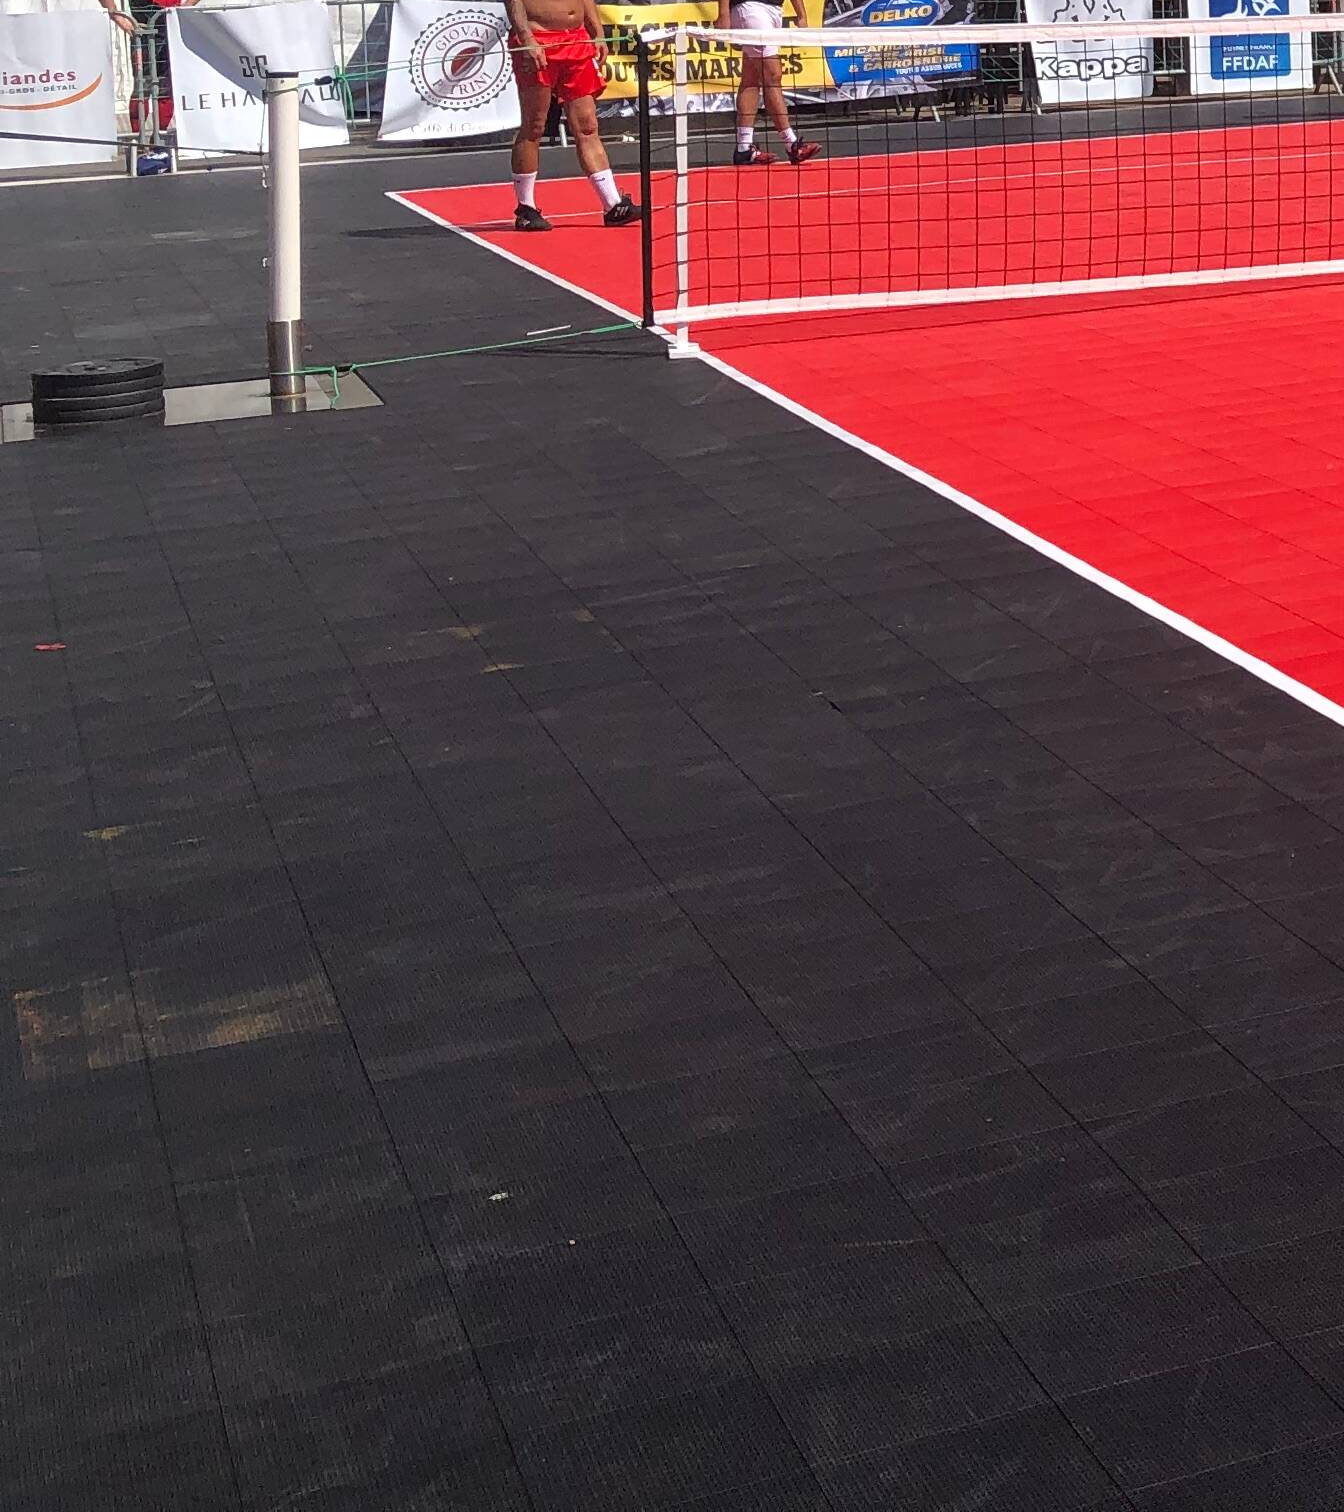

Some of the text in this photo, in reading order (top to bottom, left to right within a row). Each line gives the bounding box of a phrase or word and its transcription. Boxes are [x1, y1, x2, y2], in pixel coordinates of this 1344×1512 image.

[869, 5, 934, 24] DELKO
[1035, 55, 1150, 81] Kappa
[1222, 54, 1279, 72] FFDAF
[182, 93, 212, 111] LE
